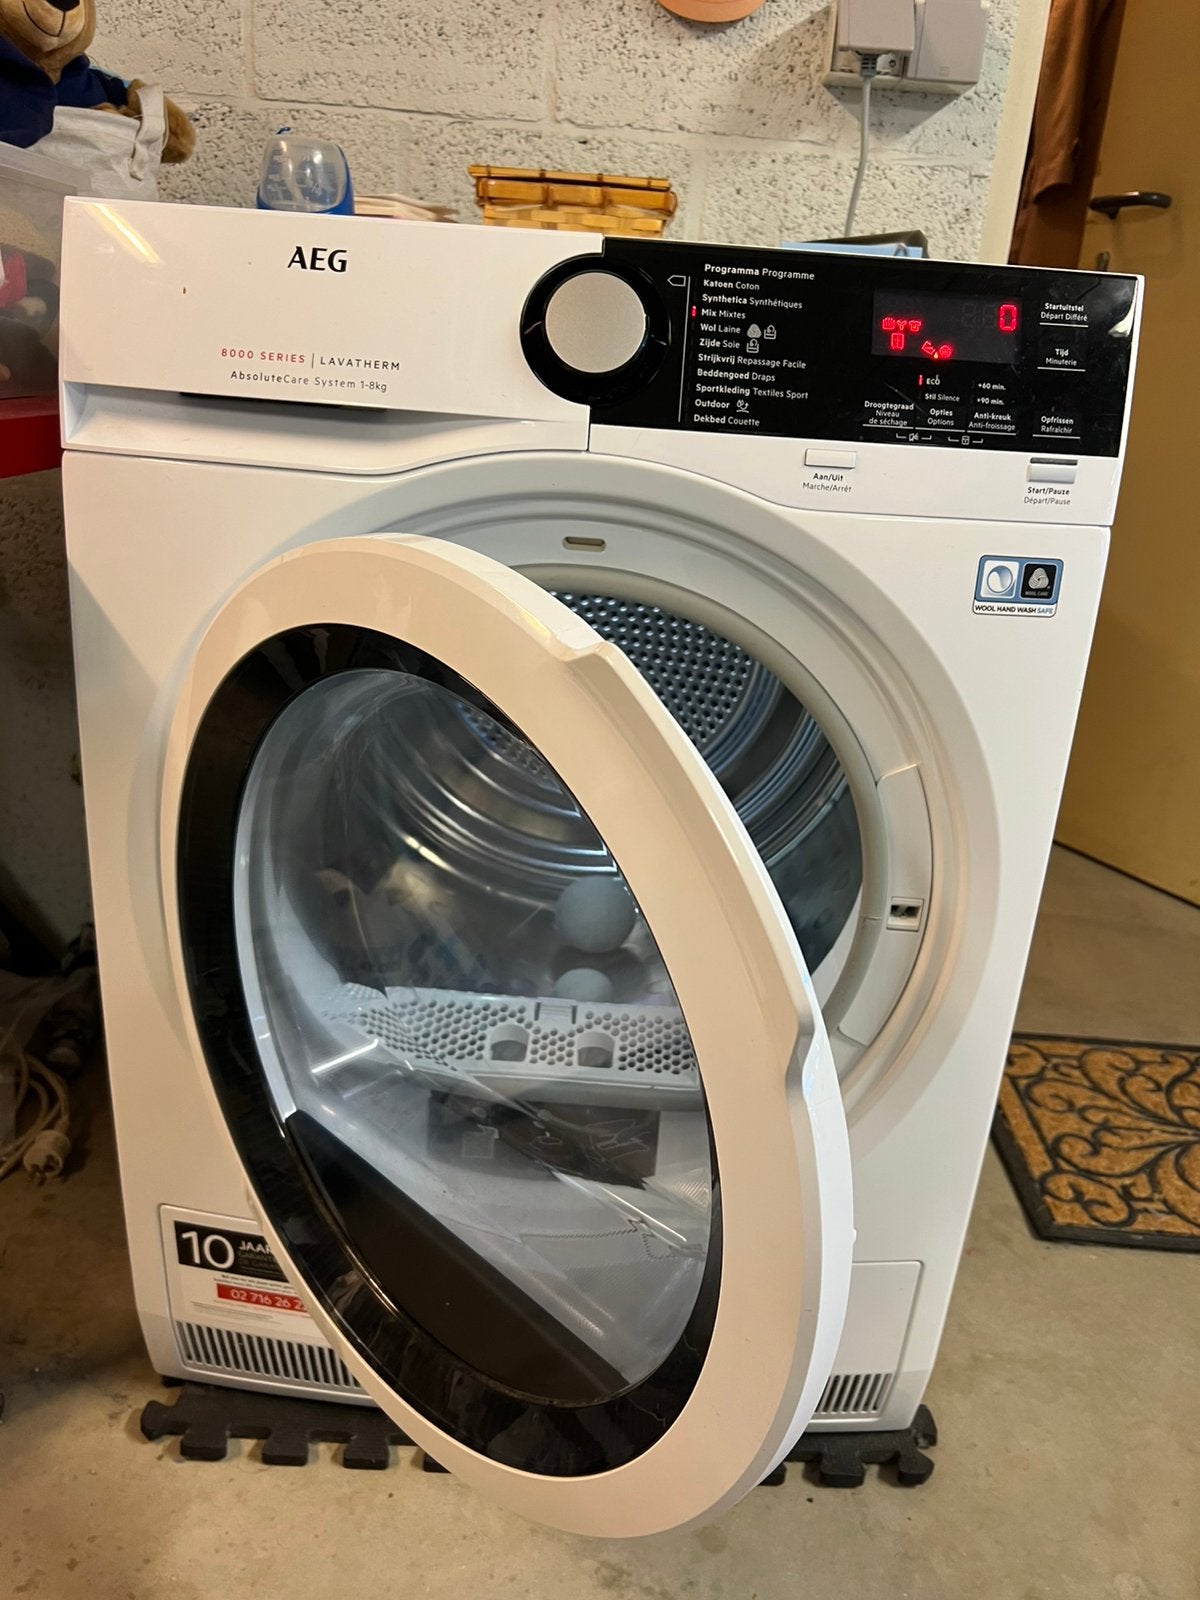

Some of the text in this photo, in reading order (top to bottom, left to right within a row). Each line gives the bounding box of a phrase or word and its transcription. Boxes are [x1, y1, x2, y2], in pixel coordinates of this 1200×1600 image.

[287, 246, 348, 273] AEG
[704, 263, 815, 280] Programma Programme
[703, 280, 760, 290] Katoen Coton
[702, 293, 803, 309] Synthetica Synthétiques
[1044, 302, 1084, 312] Startuitstel
[701, 309, 746, 319] Mix Mixtes
[999, 304, 1017, 331] 0
[1040, 311, 1088, 322] Départ Différé
[700, 323, 741, 334] Wol Laine
[699, 338, 740, 349] Zijde Soie
[1055, 348, 1069, 357] Tijd
[221, 348, 400, 371] 8000 SERIES LAVATHERM
[698, 353, 806, 369] Strijkvrij Repassage Facile
[1046, 357, 1077, 366] Minuterie
[697, 368, 776, 382] Beddengoed Draps
[230, 371, 387, 393] AbsoluteCare System 1-8kg
[696, 384, 809, 400] Sportkleding Textiles Sport
[937, 394, 960, 402] Silence
[695, 399, 730, 409] Outdoor
[864, 401, 914, 410] Droogtegraad
[930, 408, 953, 417] Opties
[974, 412, 1011, 421] Anti-kreuk
[694, 414, 760, 426] Dekbed Couette
[880, 418, 907, 427] séchage
[927, 417, 954, 426] Options
[1041, 416, 1074, 425] Opfrissen
[968, 421, 1016, 431] Anti-froissage
[813, 473, 843, 481] Aan/Uit
[1028, 486, 1070, 495] Start/Pauze
[181, 1230, 235, 1270] 10
[230, 1289, 247, 1299] 02
[250, 1292, 272, 1305] 716
[274, 1296, 291, 1307] 26
[294, 1299, 305, 1310] 2
